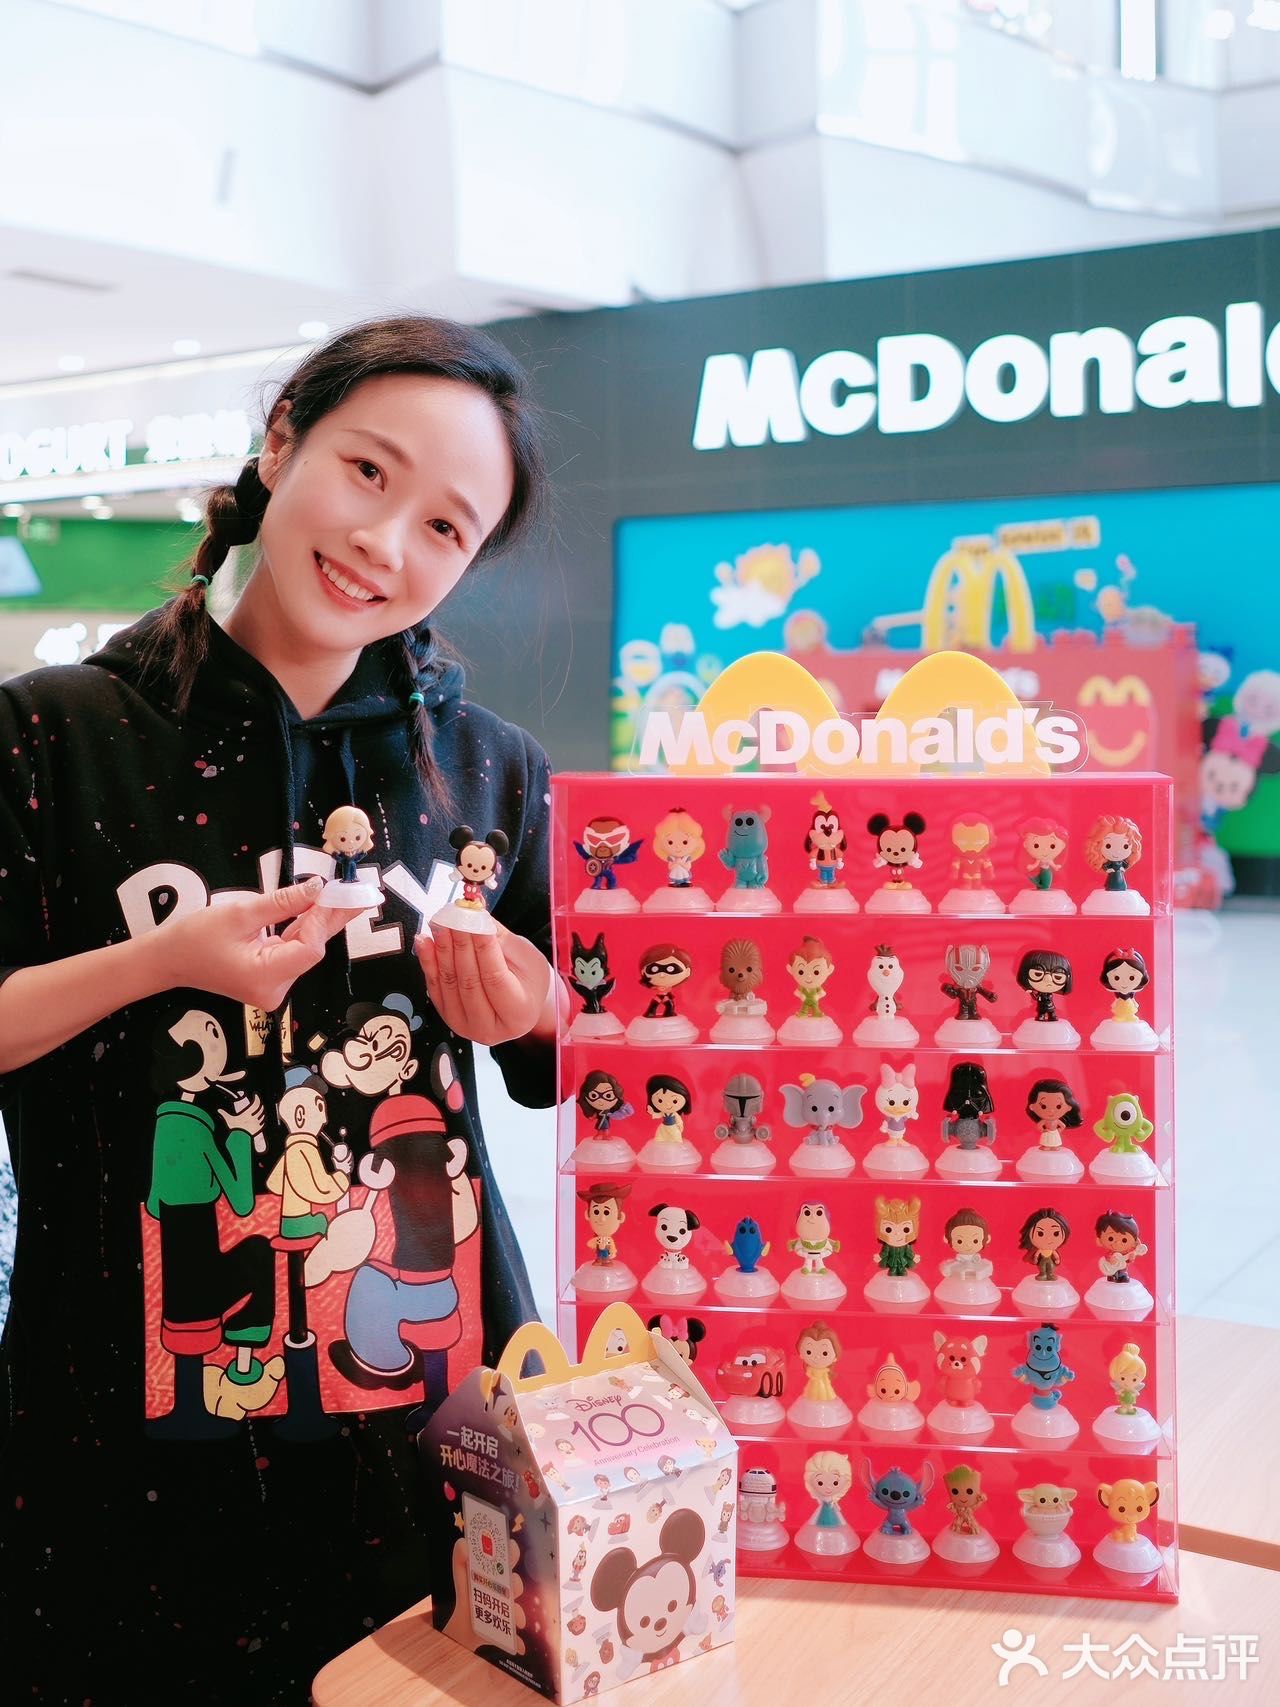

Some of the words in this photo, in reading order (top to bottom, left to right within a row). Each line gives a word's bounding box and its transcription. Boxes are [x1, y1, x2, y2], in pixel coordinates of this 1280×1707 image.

[639, 707, 1081, 766] McDonald's
[566, 1395, 622, 1412] Disney
[446, 1425, 499, 1460] 一起开启
[571, 1403, 665, 1452] 100
[594, 1447, 638, 1466] Anniversary
[638, 1435, 680, 1453] Celebration
[473, 1587, 510, 1619] 扫码开启
[474, 1604, 512, 1636] 更多欢乐
